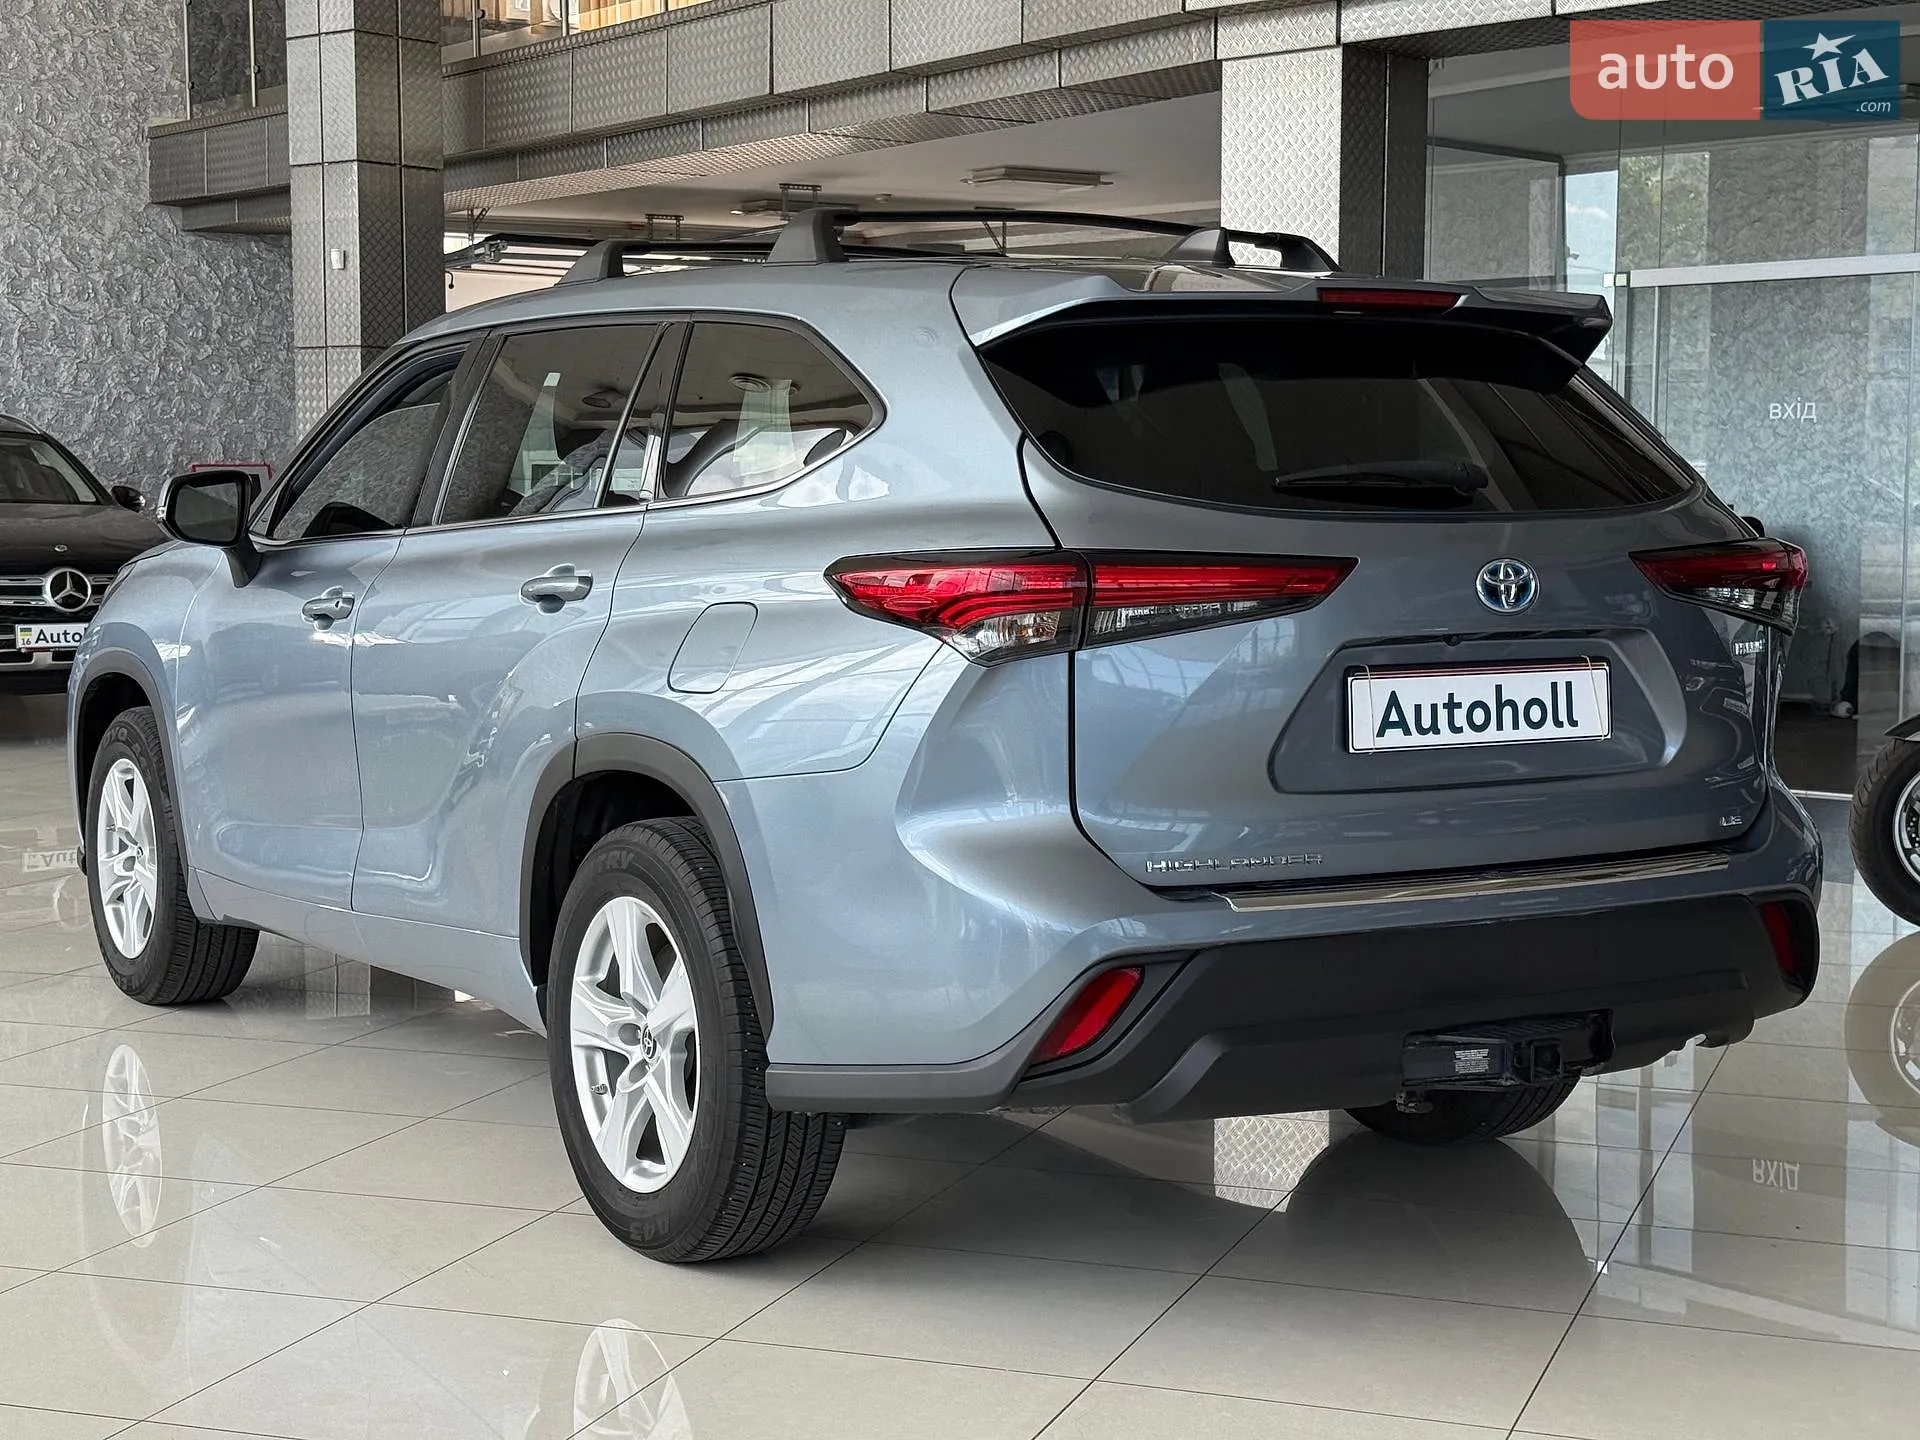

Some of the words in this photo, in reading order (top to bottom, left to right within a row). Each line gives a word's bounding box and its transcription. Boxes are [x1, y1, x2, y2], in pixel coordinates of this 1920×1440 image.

[1769, 396, 1817, 424] вхід
[21, 638, 32, 646] 16
[35, 628, 87, 644] Auto
[1375, 680, 1579, 738] Autoholl
[1720, 815, 1743, 827] LE
[1145, 853, 1323, 873] HIGHLANDER
